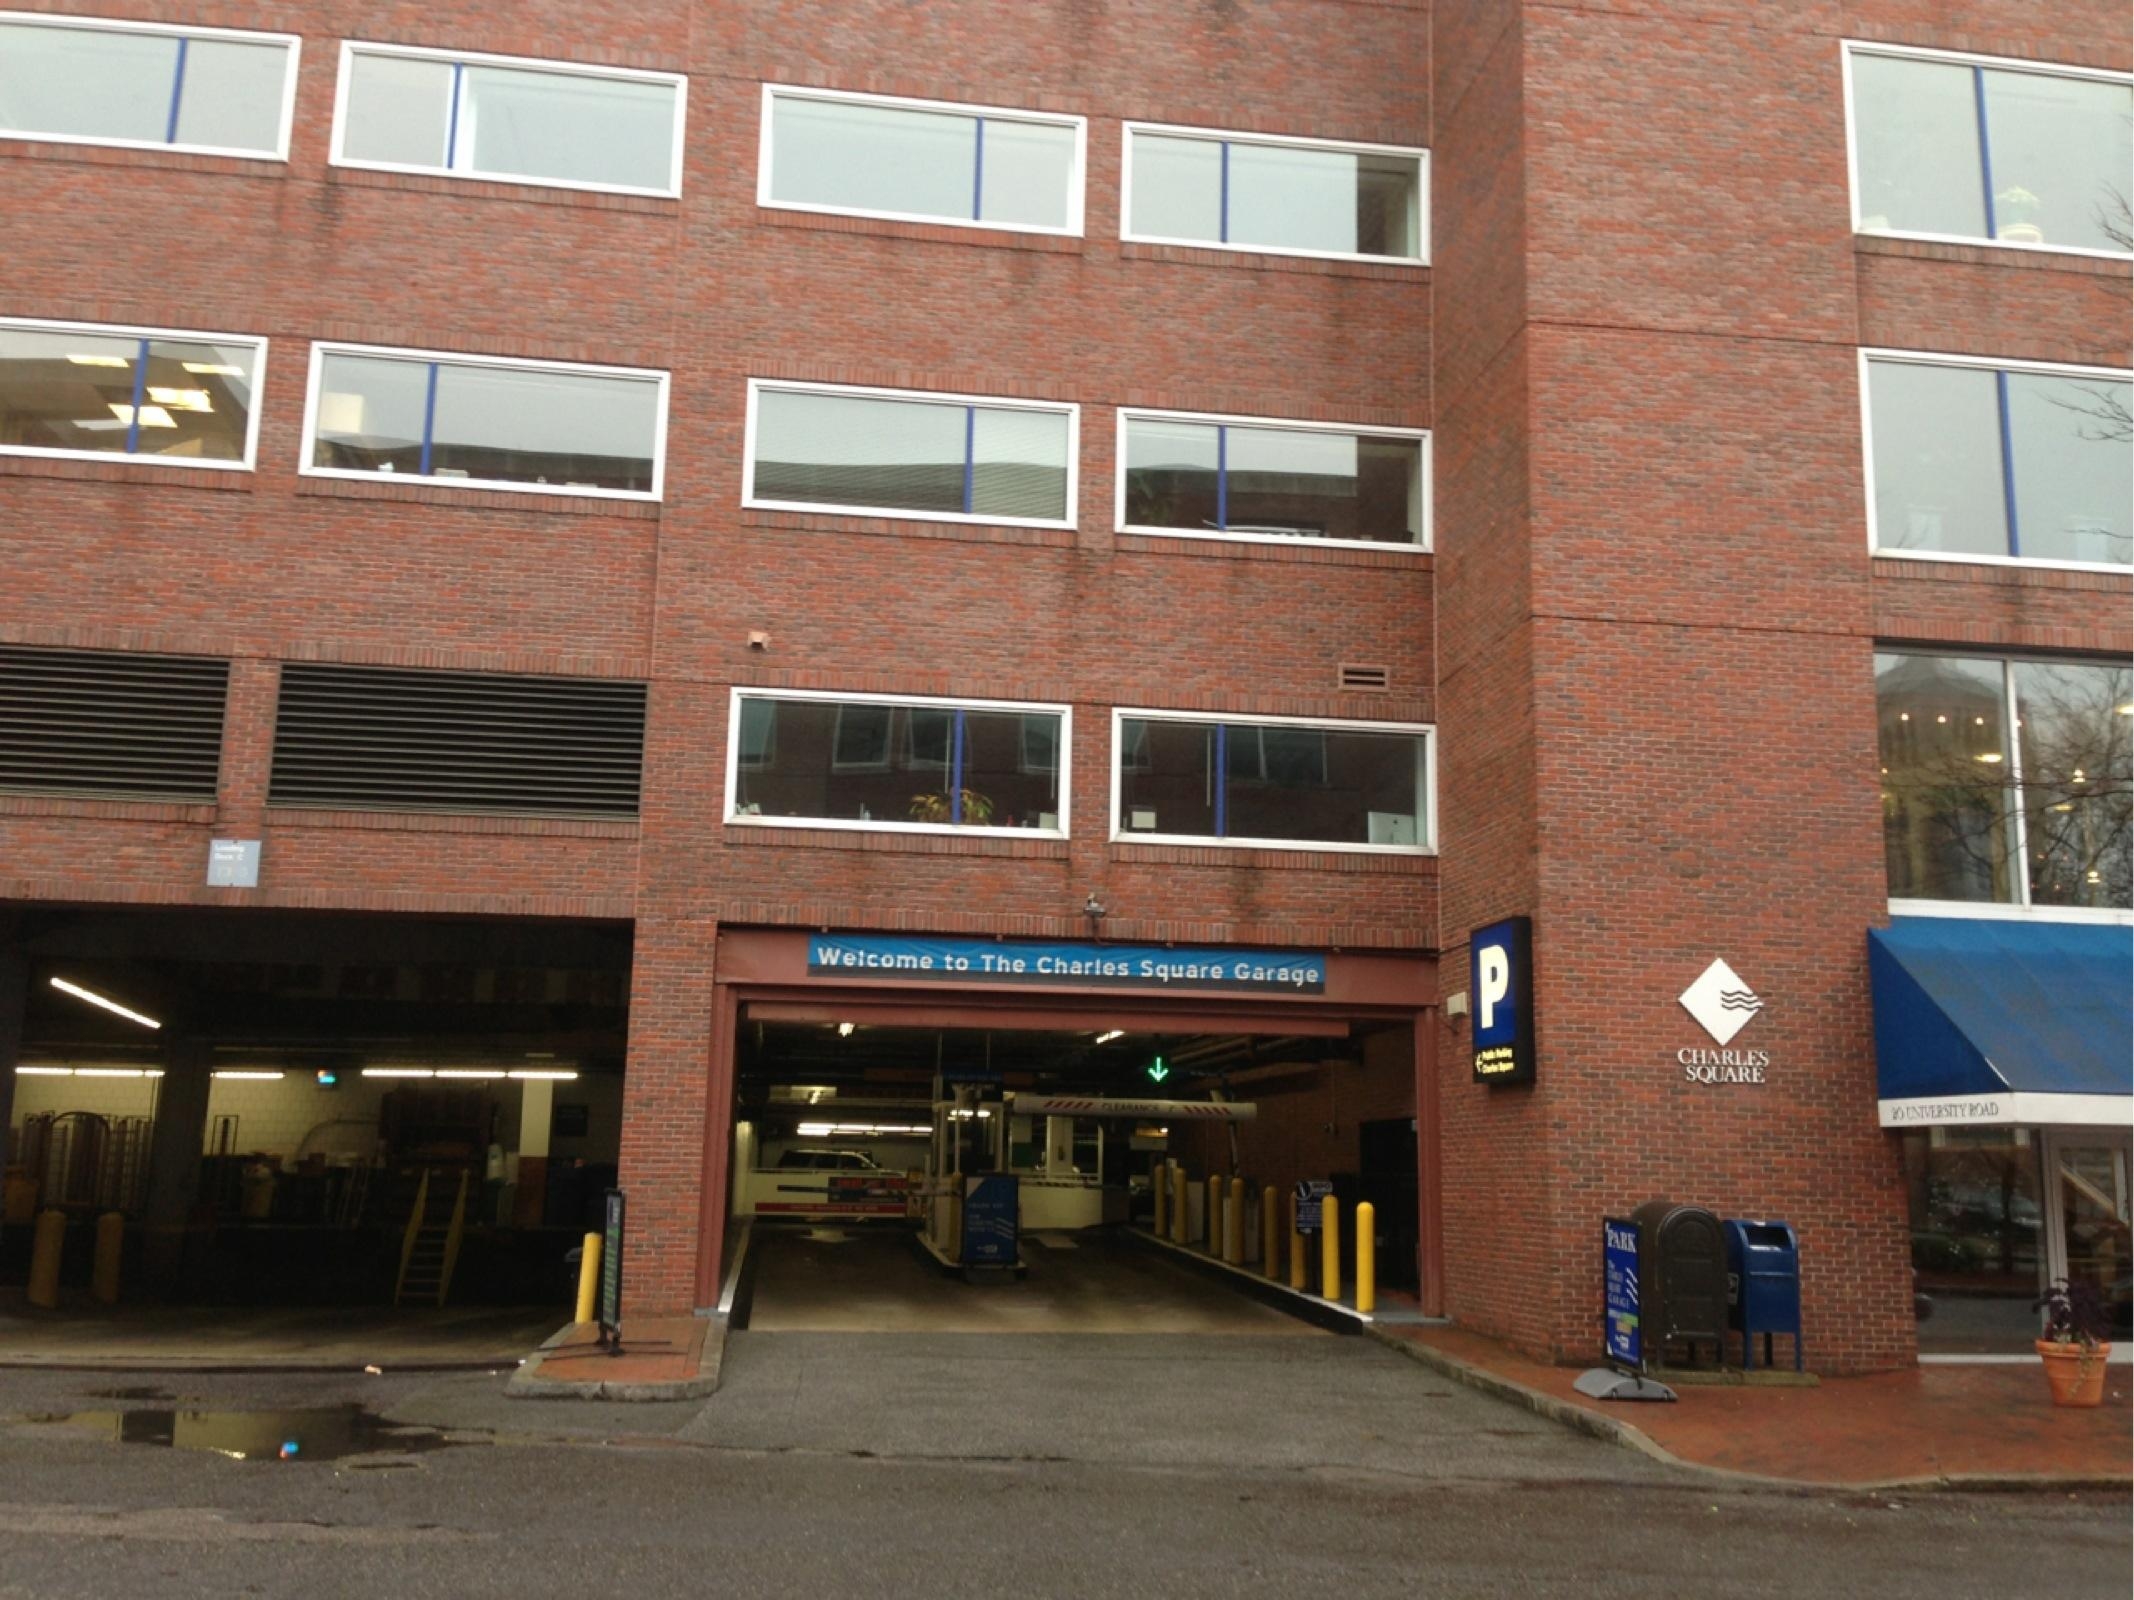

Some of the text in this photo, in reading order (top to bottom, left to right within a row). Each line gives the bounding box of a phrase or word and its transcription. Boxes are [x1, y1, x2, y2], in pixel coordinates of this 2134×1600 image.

[817, 947, 1319, 987] Welcome to The Charles Square Garage
[1480, 945, 1509, 1029] P
[1677, 1048, 1769, 1067] CHARLES
[1686, 1065, 1766, 1084] SQUARE
[1906, 1103, 1967, 1120] UNIVERSITY
[1969, 1102, 1999, 1118] ROAD
[1607, 1229, 1637, 1253] PARK
